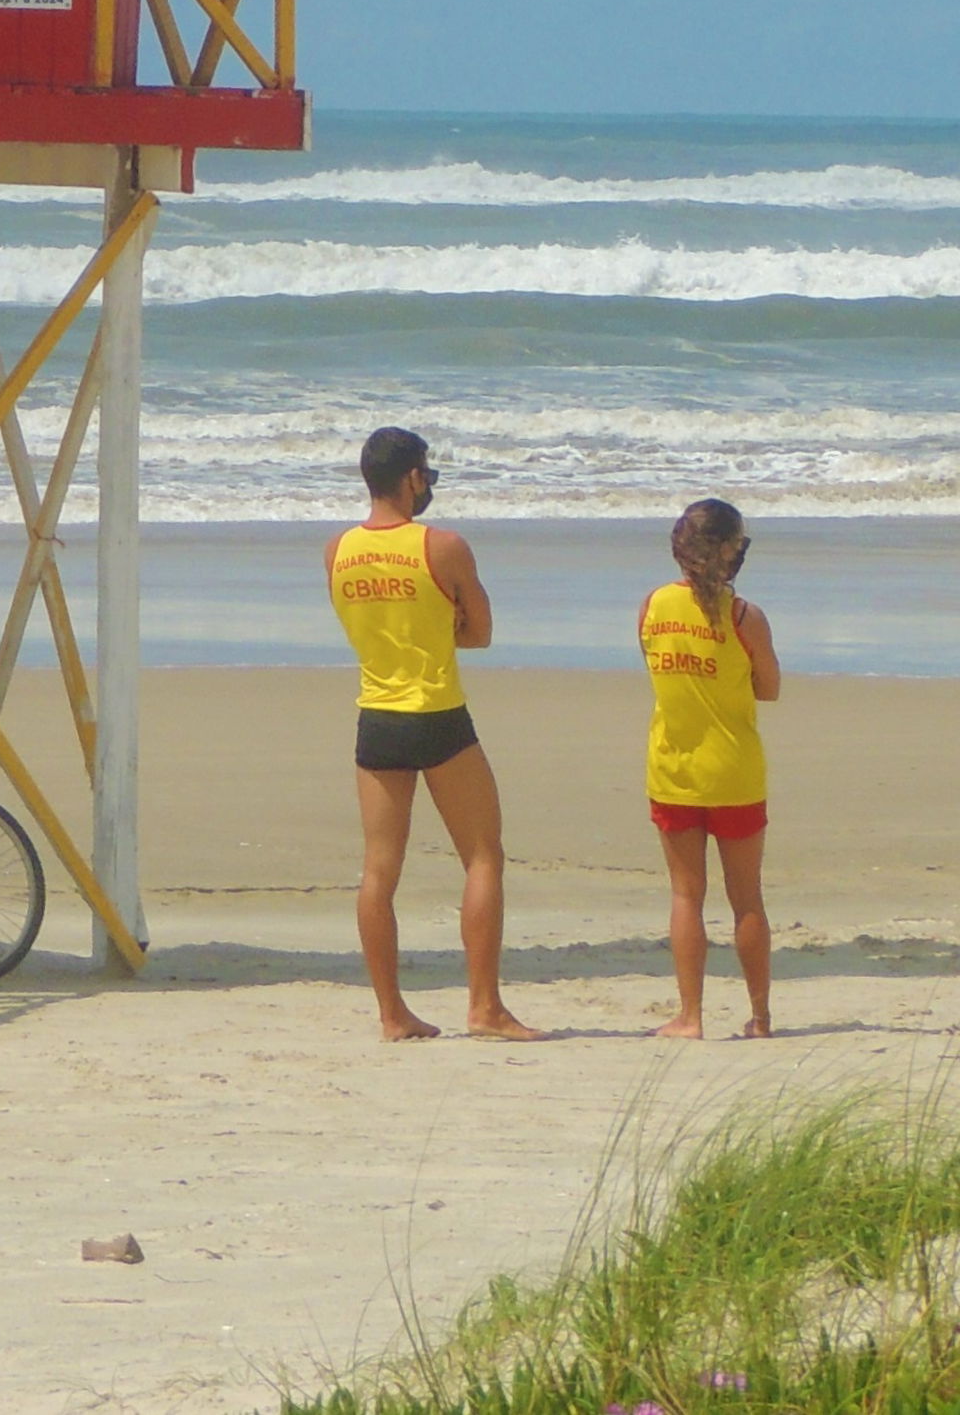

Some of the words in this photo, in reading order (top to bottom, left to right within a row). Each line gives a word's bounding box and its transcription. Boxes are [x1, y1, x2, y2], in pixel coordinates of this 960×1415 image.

[336, 552, 420, 573] GUARDA-VIDAS
[343, 578, 417, 599] CBMRS
[646, 620, 726, 644] UARDA-VIDAS
[650, 652, 718, 674] CBMRS
